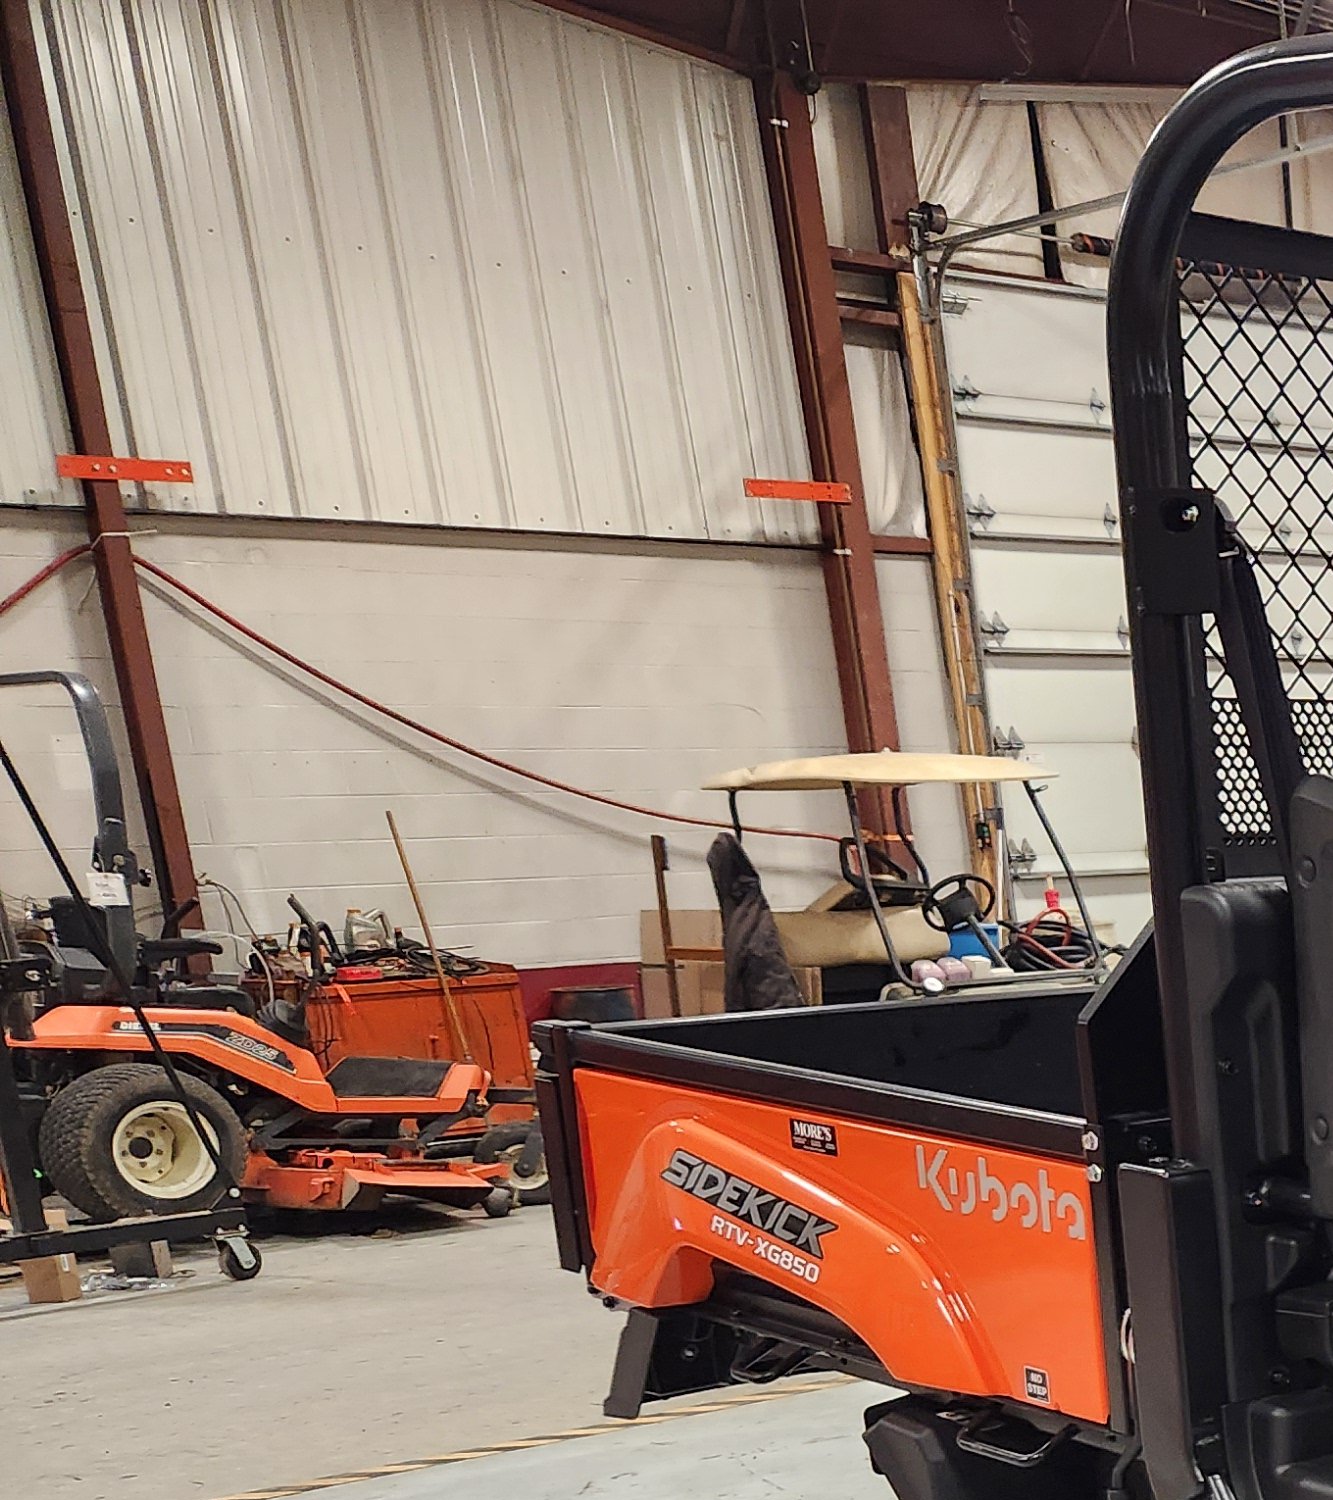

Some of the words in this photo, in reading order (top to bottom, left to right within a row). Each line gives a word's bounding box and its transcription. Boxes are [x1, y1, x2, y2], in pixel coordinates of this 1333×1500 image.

[793, 1120, 832, 1142] MORE'S
[660, 1149, 838, 1258] SIDEKICK
[915, 1144, 1087, 1240] Kubota
[711, 1215, 820, 1283] RTV-XG850
[1027, 1382, 1047, 1396] STEP
[1030, 1372, 1043, 1384] NO
